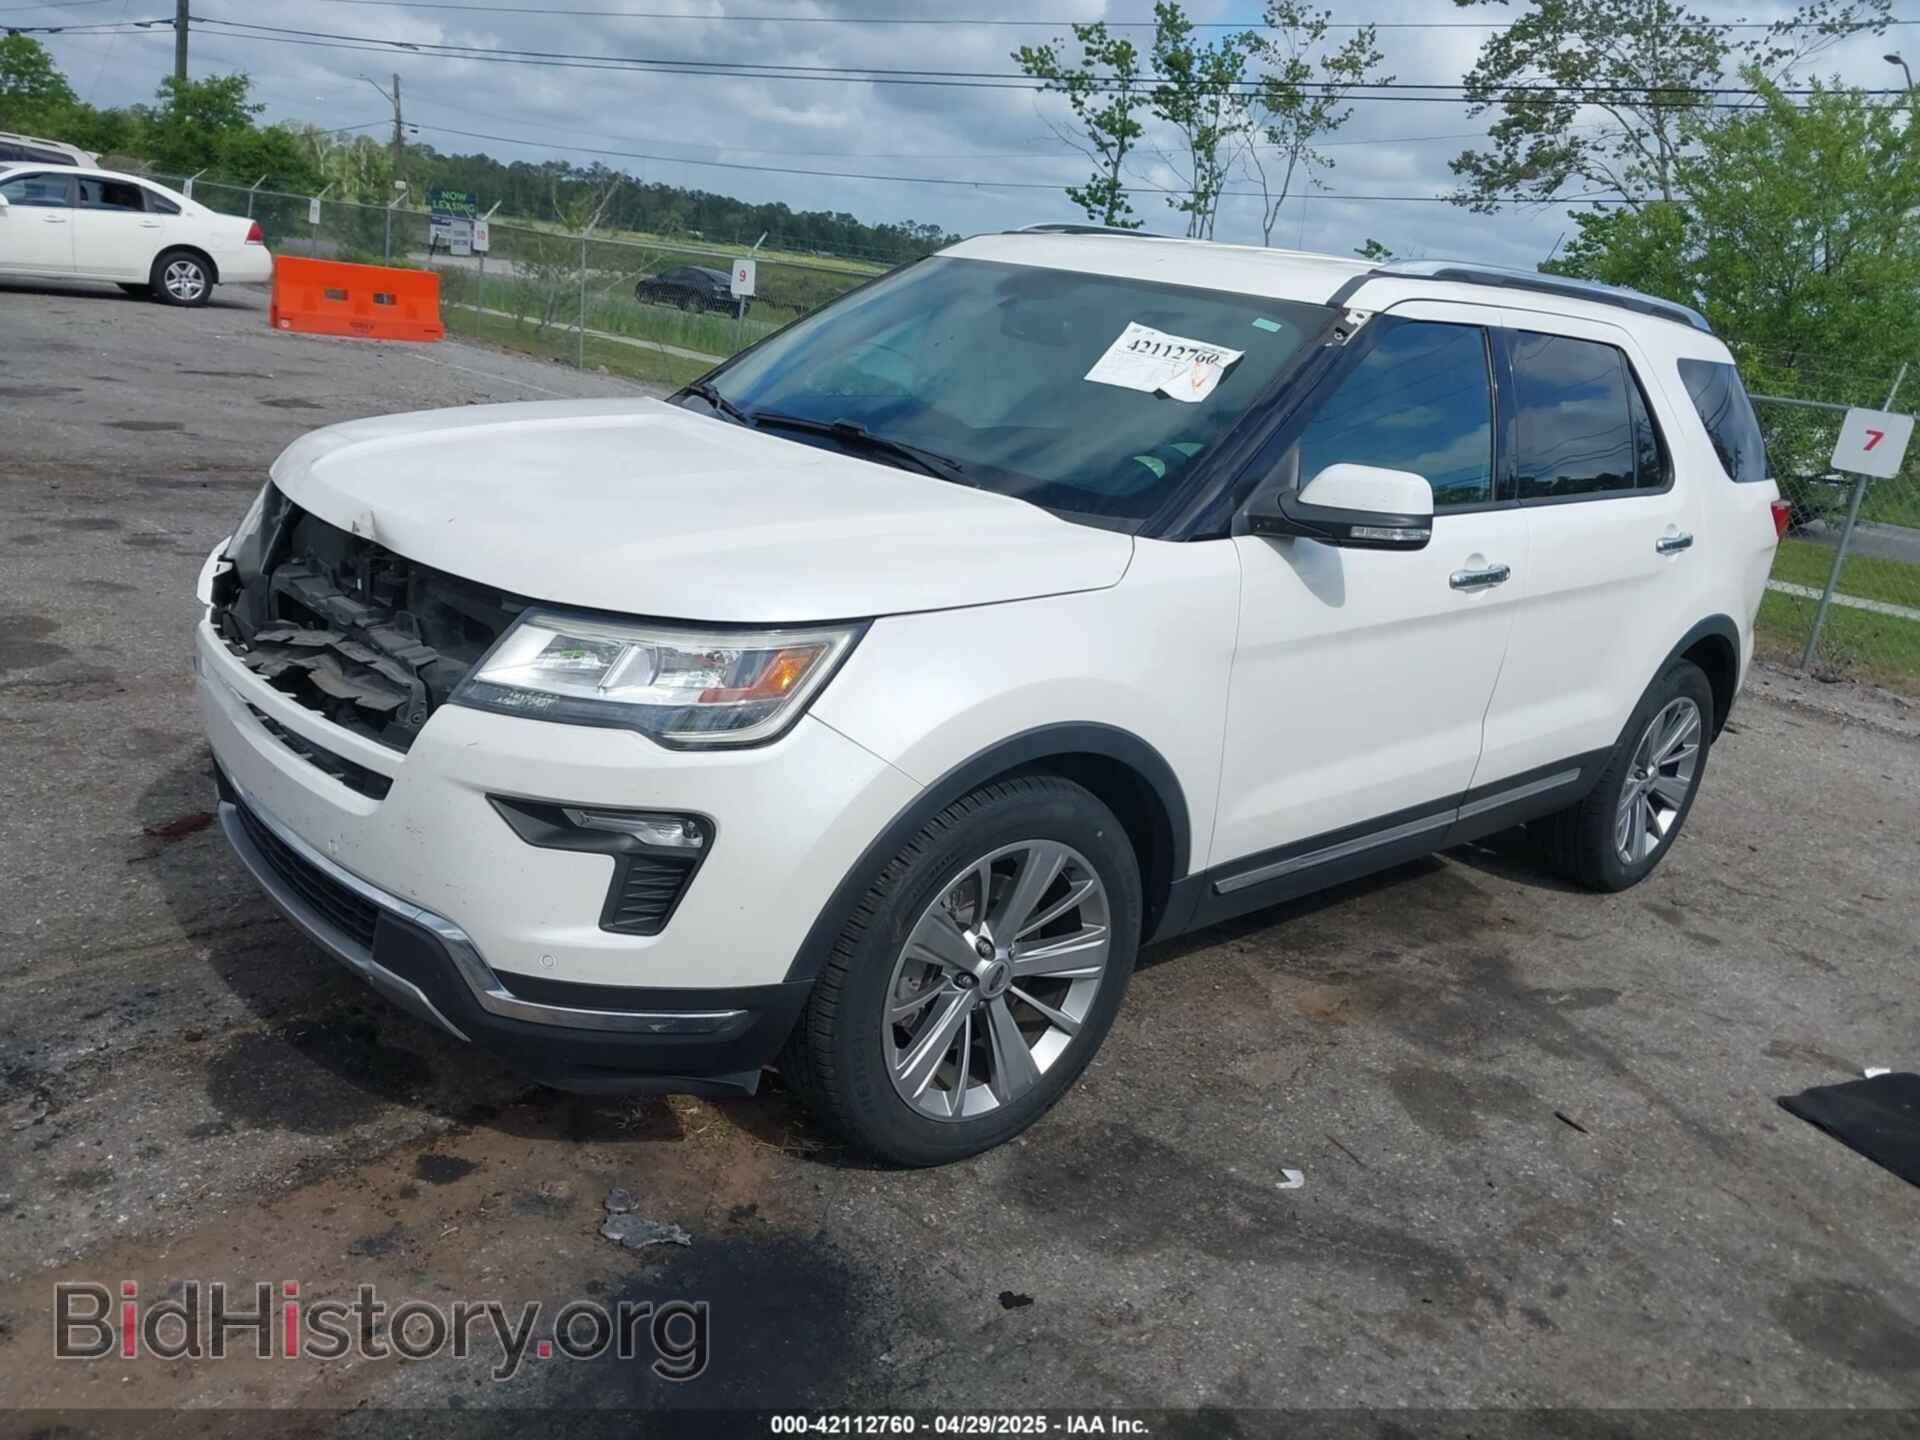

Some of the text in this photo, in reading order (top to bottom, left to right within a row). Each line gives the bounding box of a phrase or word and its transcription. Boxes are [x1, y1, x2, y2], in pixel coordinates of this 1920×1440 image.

[441, 191, 467, 201] NOW
[432, 200, 476, 213] LEASING
[739, 270, 747, 282] 9
[1127, 339, 1220, 365] 42112760
[1863, 429, 1885, 452] 7
